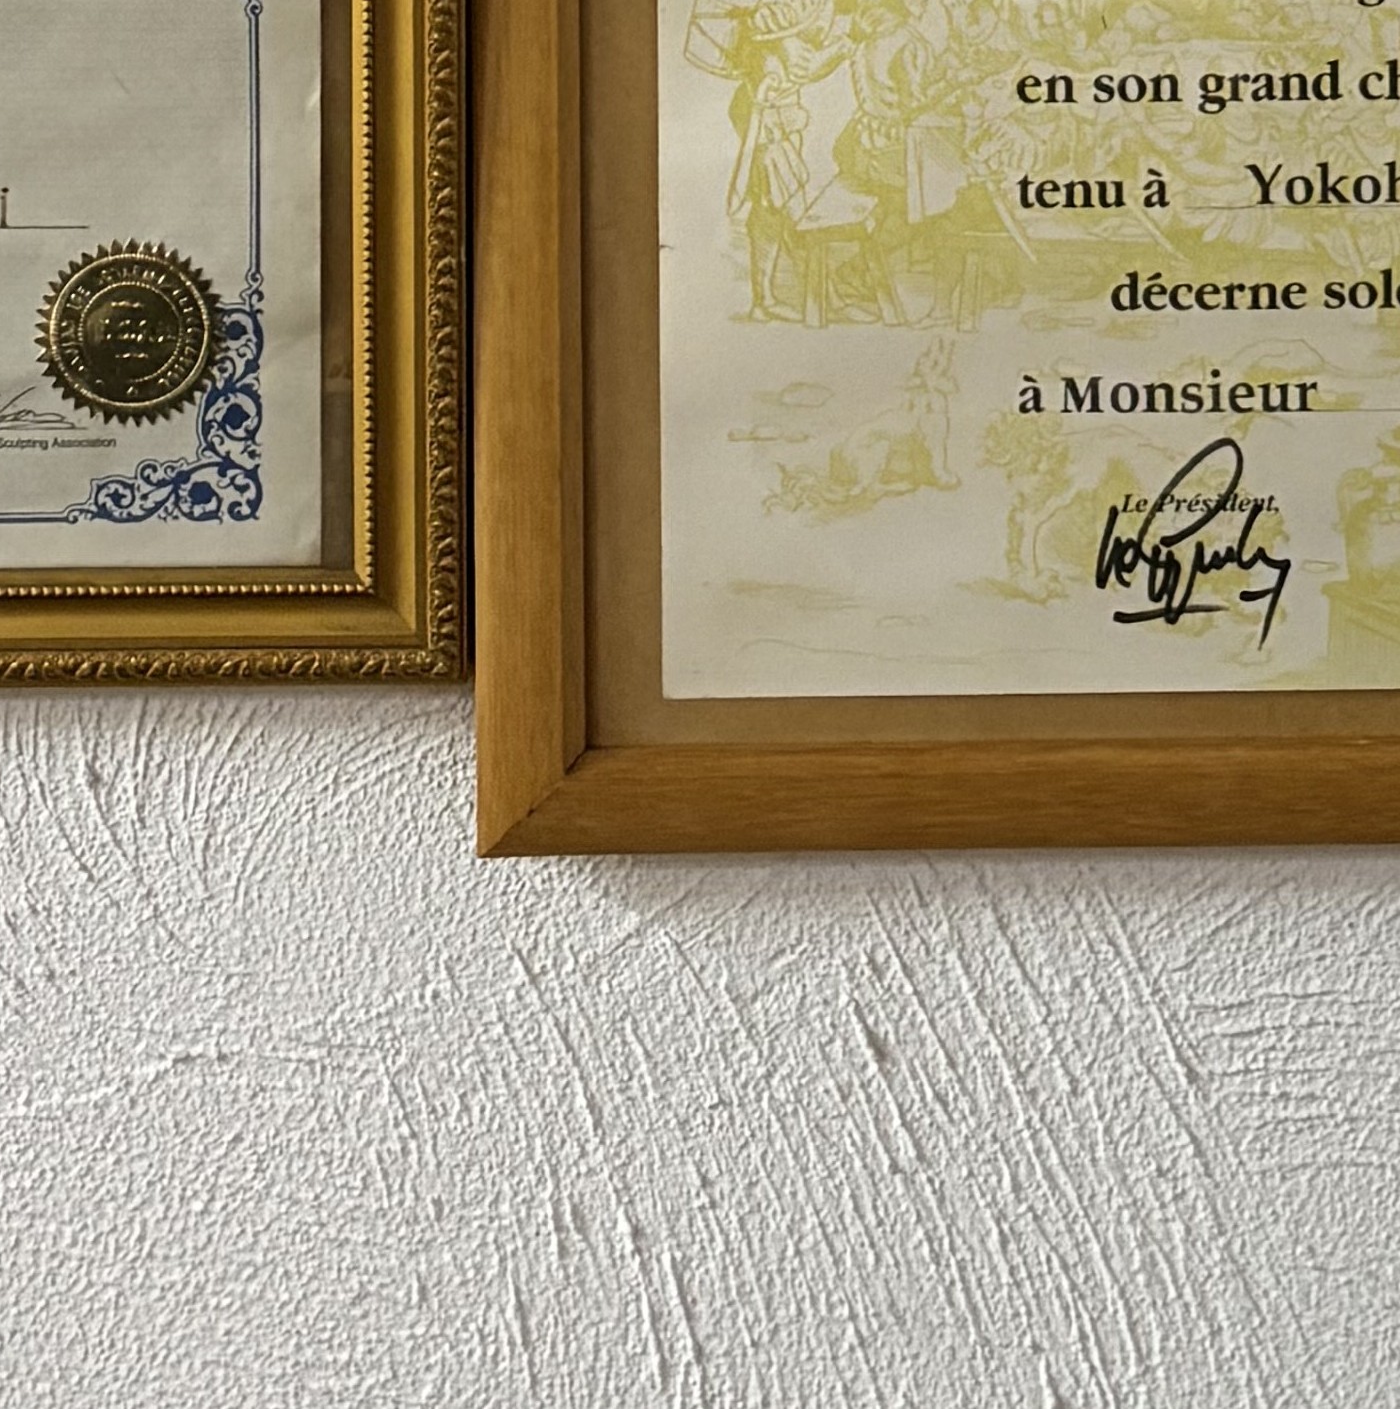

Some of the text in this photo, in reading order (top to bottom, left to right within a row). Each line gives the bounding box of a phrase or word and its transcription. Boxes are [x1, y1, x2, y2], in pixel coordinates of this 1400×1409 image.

[1015, 74, 1074, 104] en
[1092, 73, 1183, 104] son
[1198, 60, 1341, 115] grand
[1018, 172, 1126, 210] tenu
[1141, 168, 1171, 209] à
[1110, 270, 1308, 312] décerne
[1017, 374, 1045, 415] à
[1059, 368, 1319, 415] Monsieur
[51, 436, 117, 449] Association
[1121, 494, 1149, 514] Le
